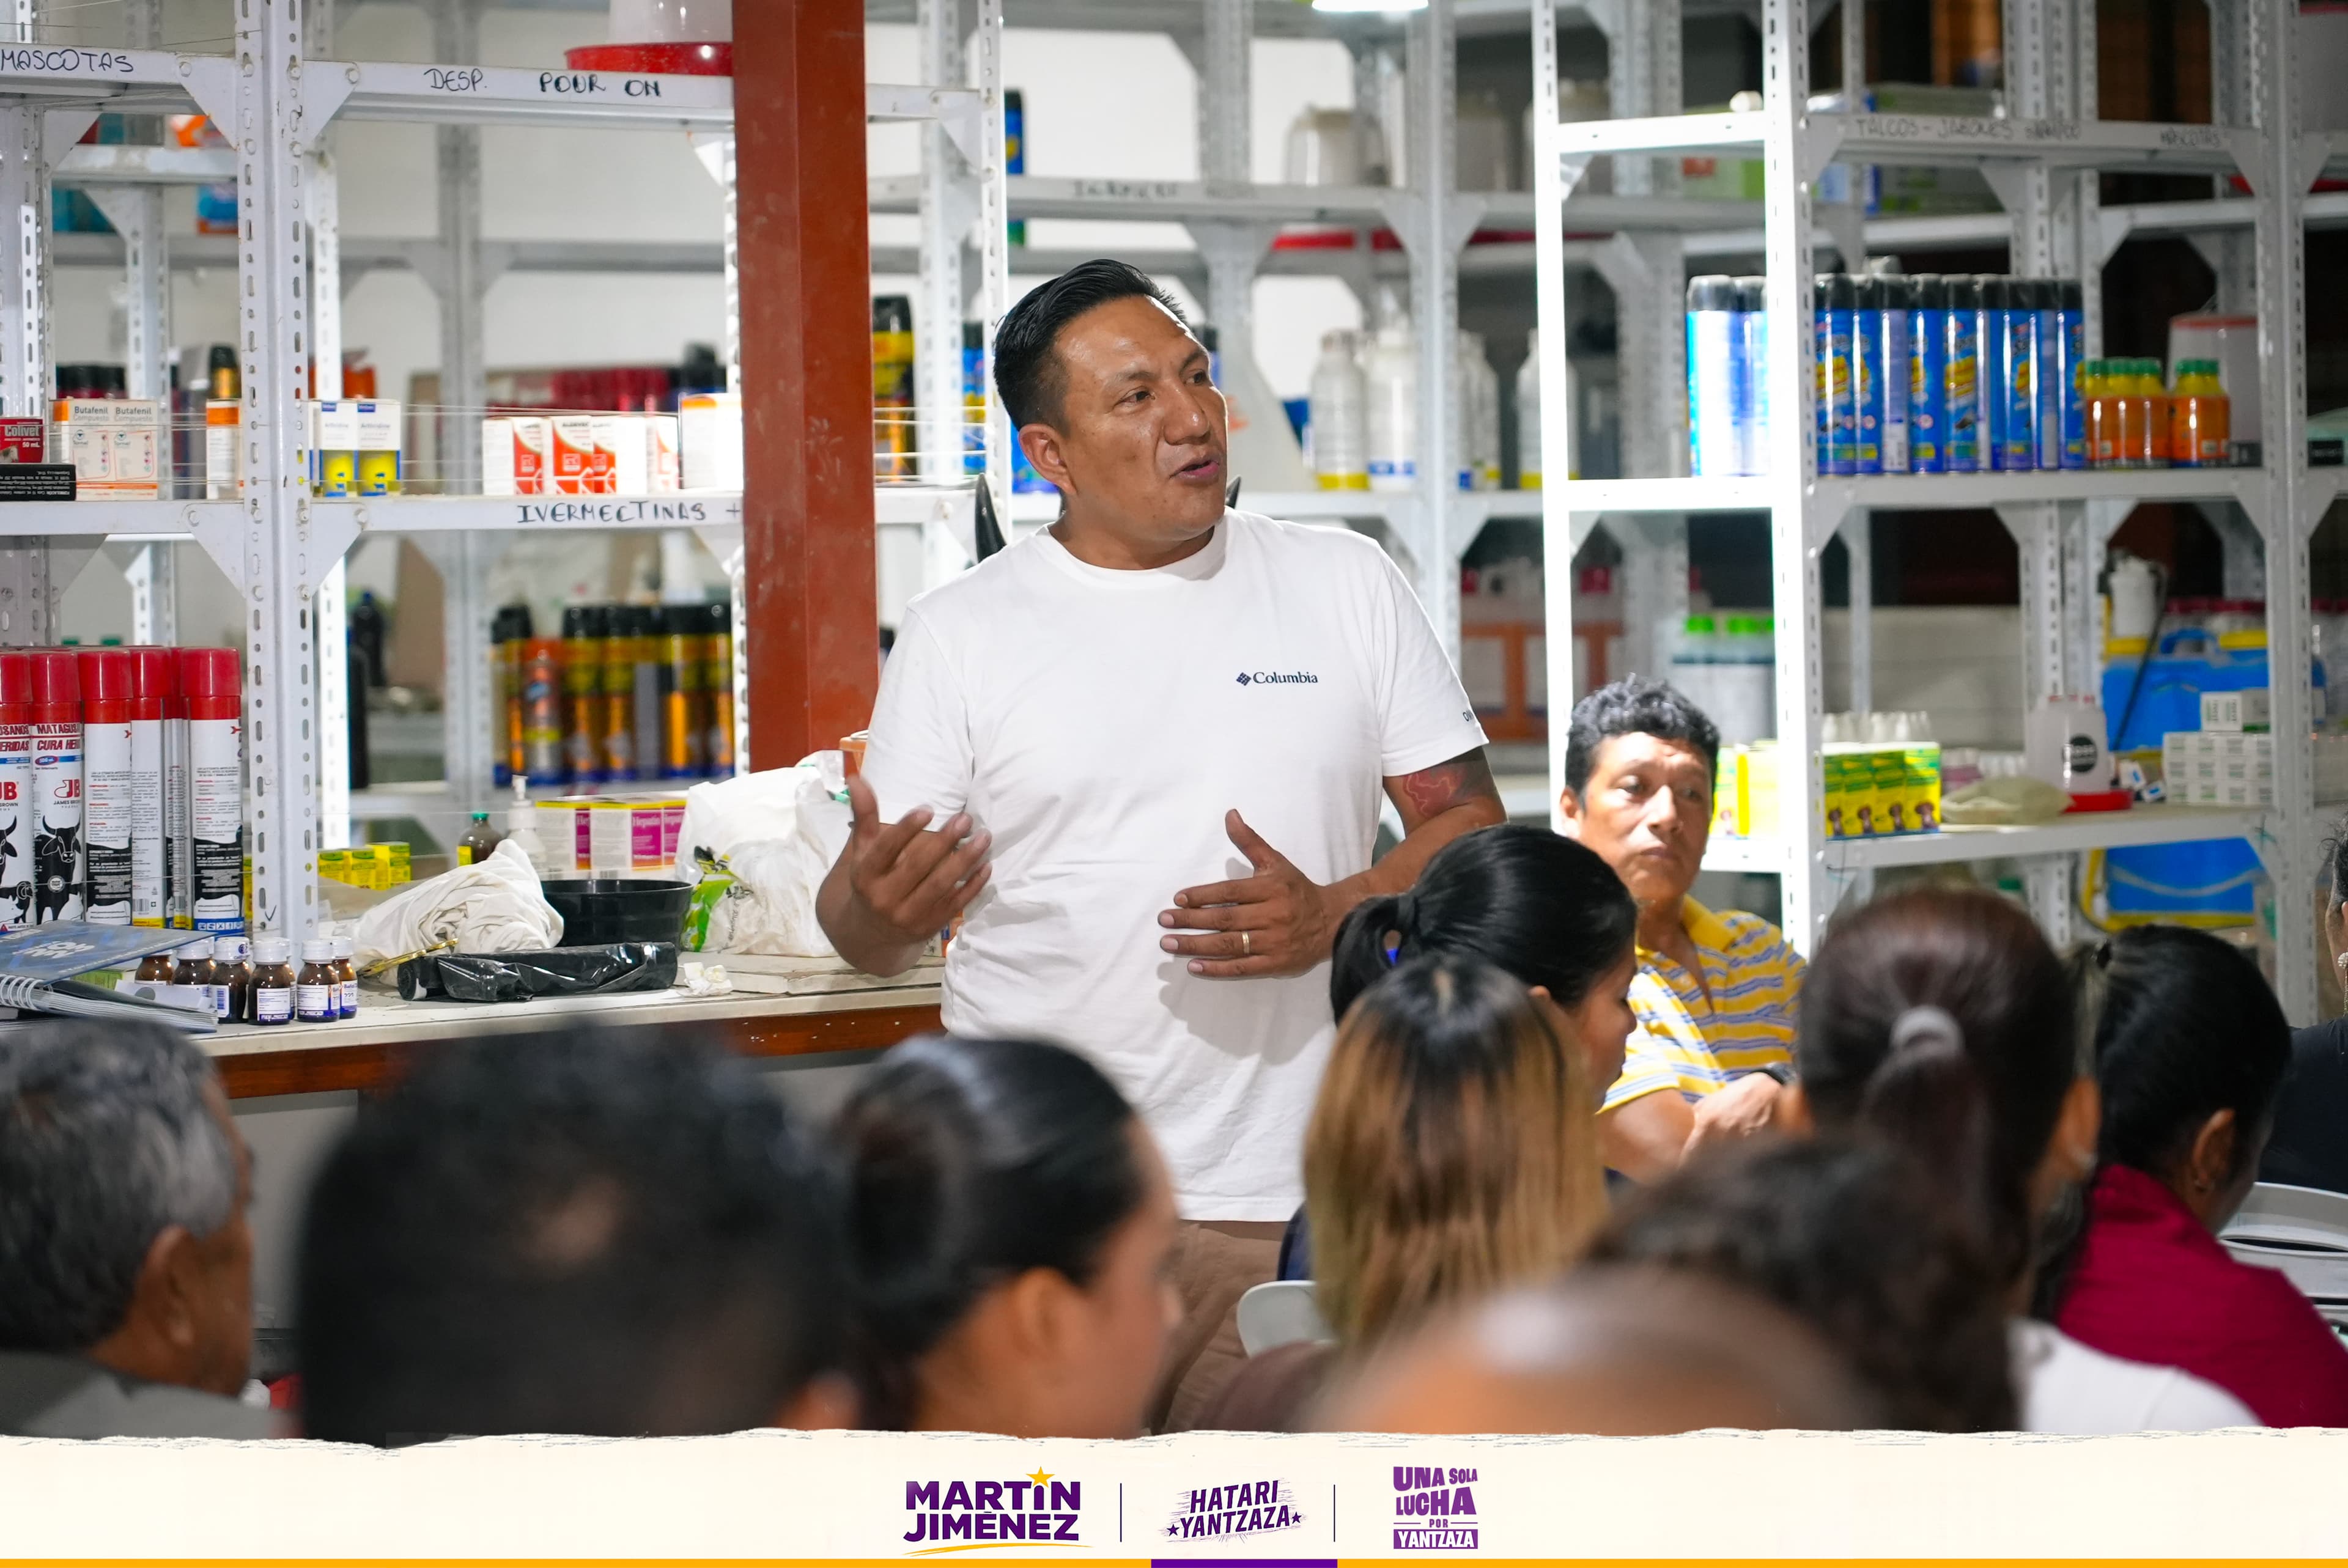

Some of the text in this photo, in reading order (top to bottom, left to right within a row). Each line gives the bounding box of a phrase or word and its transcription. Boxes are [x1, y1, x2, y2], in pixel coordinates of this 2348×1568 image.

[1, 48, 134, 72] MASCOTAS
[424, 68, 661, 97] DESP. POUR ON
[5, 425, 40, 436] Colivet
[517, 501, 706, 523] IVERMECTINAS
[1252, 672, 1318, 684] Columbia
[0, 740, 29, 751] ERIDAS
[37, 740, 62, 751] CURA
